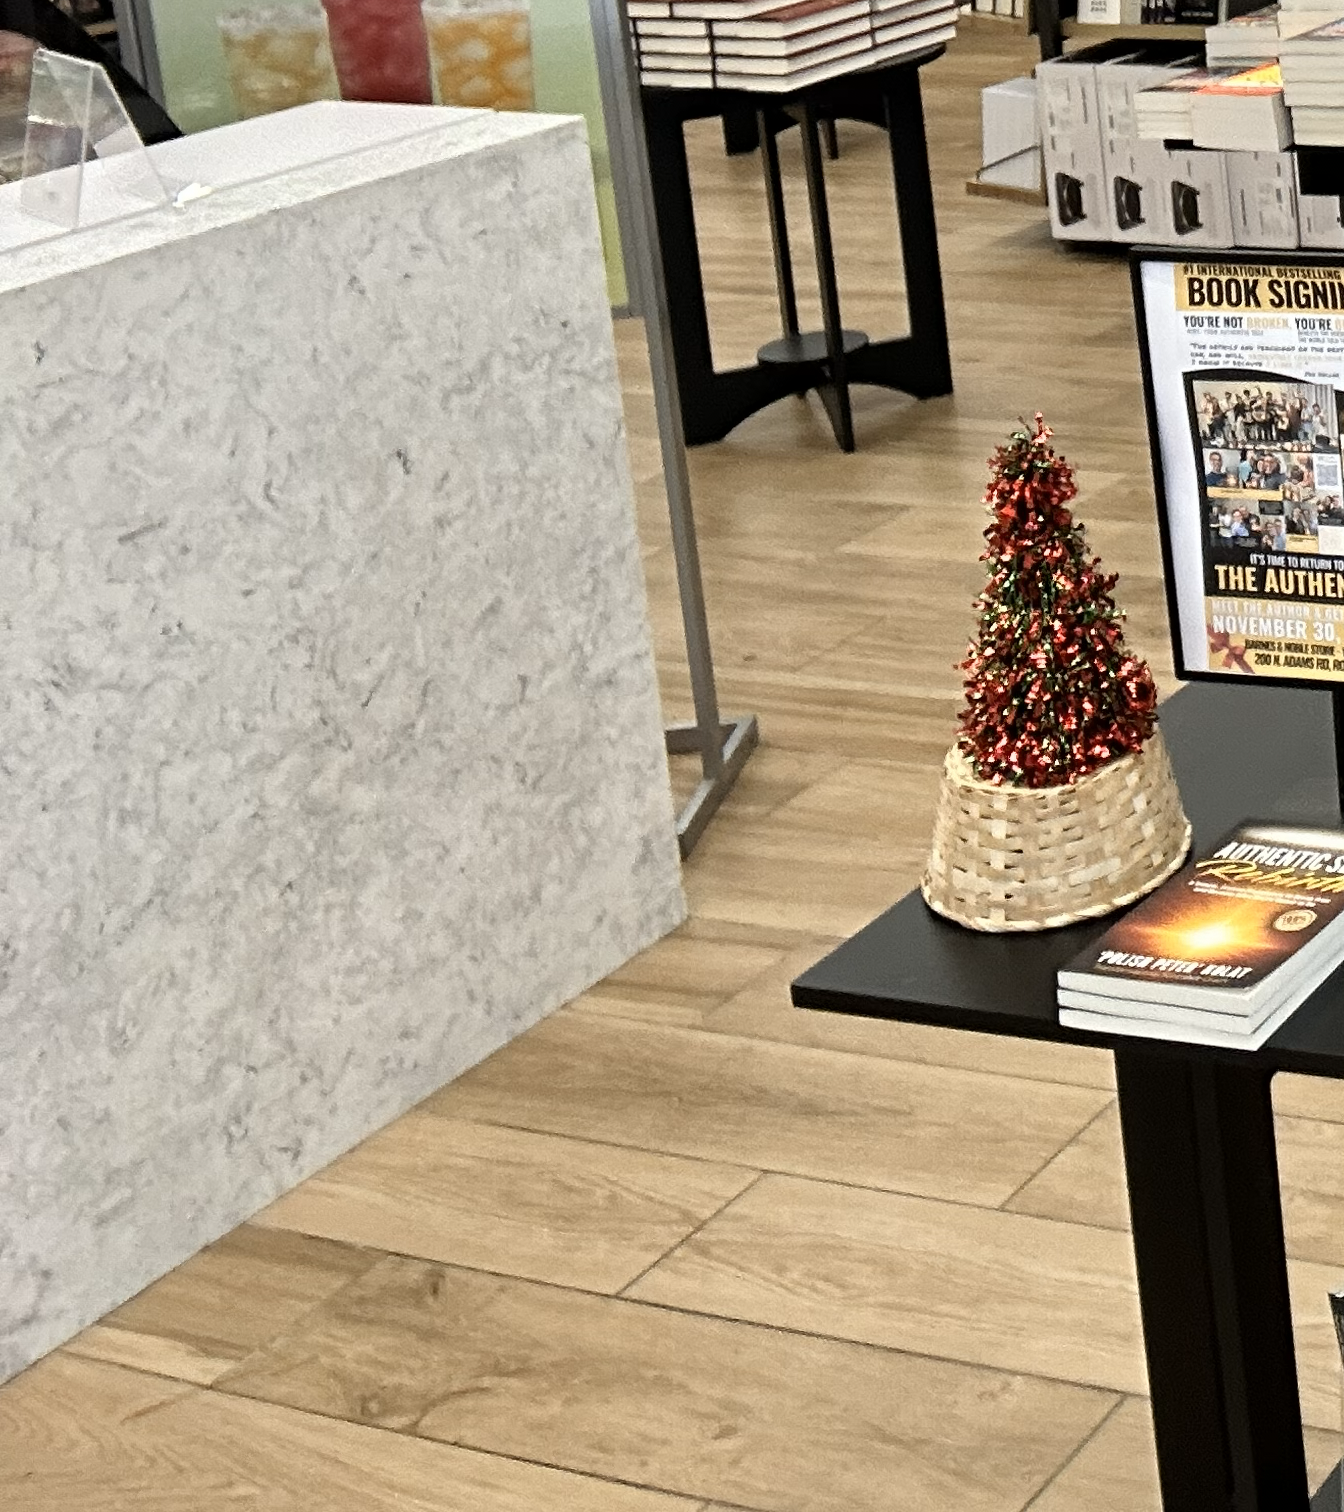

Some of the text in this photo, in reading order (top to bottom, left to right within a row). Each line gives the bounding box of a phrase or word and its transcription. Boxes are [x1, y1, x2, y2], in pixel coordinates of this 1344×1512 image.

[1183, 266, 1194, 275] #1
[1197, 266, 1274, 278] INTERNATIONAL
[1276, 269, 1341, 280] BESTSELLING
[1188, 277, 1262, 309] BOOK
[1214, 564, 1258, 592] THE
[1212, 615, 1307, 641] NOVEMBER
[1313, 621, 1341, 644] 30,
[1213, 842, 1327, 870] AUTHENTIC
